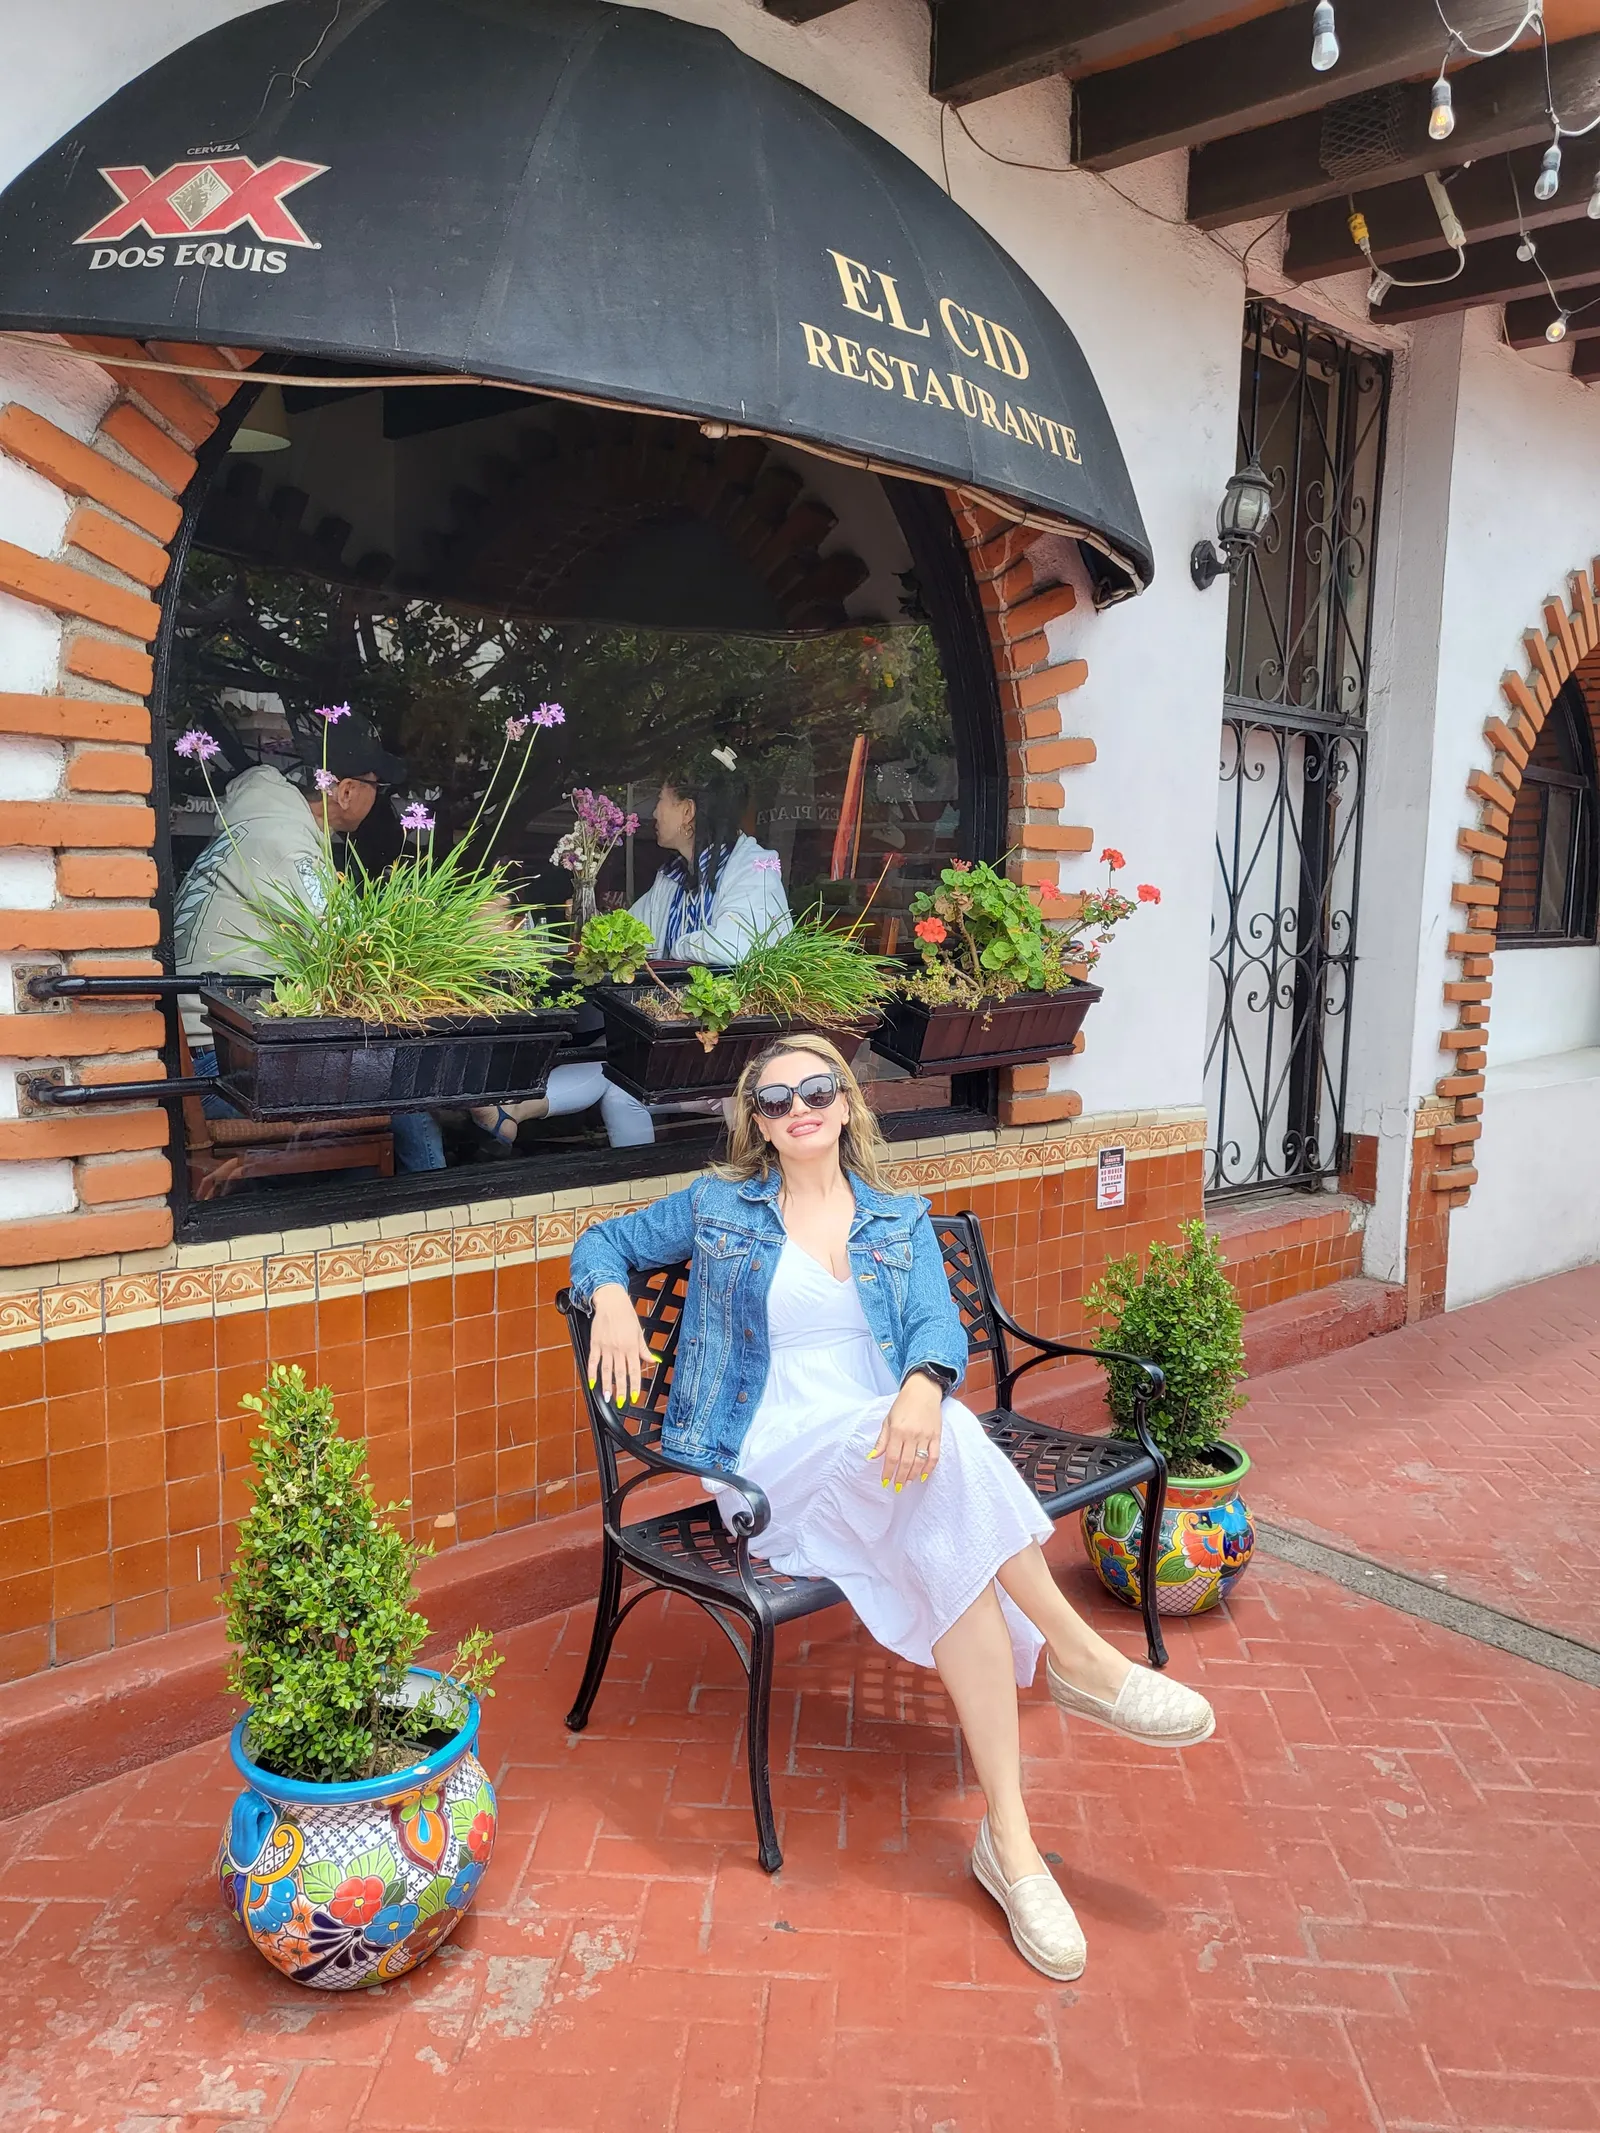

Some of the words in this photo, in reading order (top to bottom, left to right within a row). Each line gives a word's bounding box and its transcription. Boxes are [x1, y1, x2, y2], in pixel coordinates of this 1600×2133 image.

[186, 143, 240, 155] CERVEZA
[88, 245, 166, 270] DOS
[174, 242, 287, 274] EQUIS
[825, 248, 931, 338] EL
[938, 297, 1030, 381] CID
[798, 321, 1083, 465] RESTAURANTE
